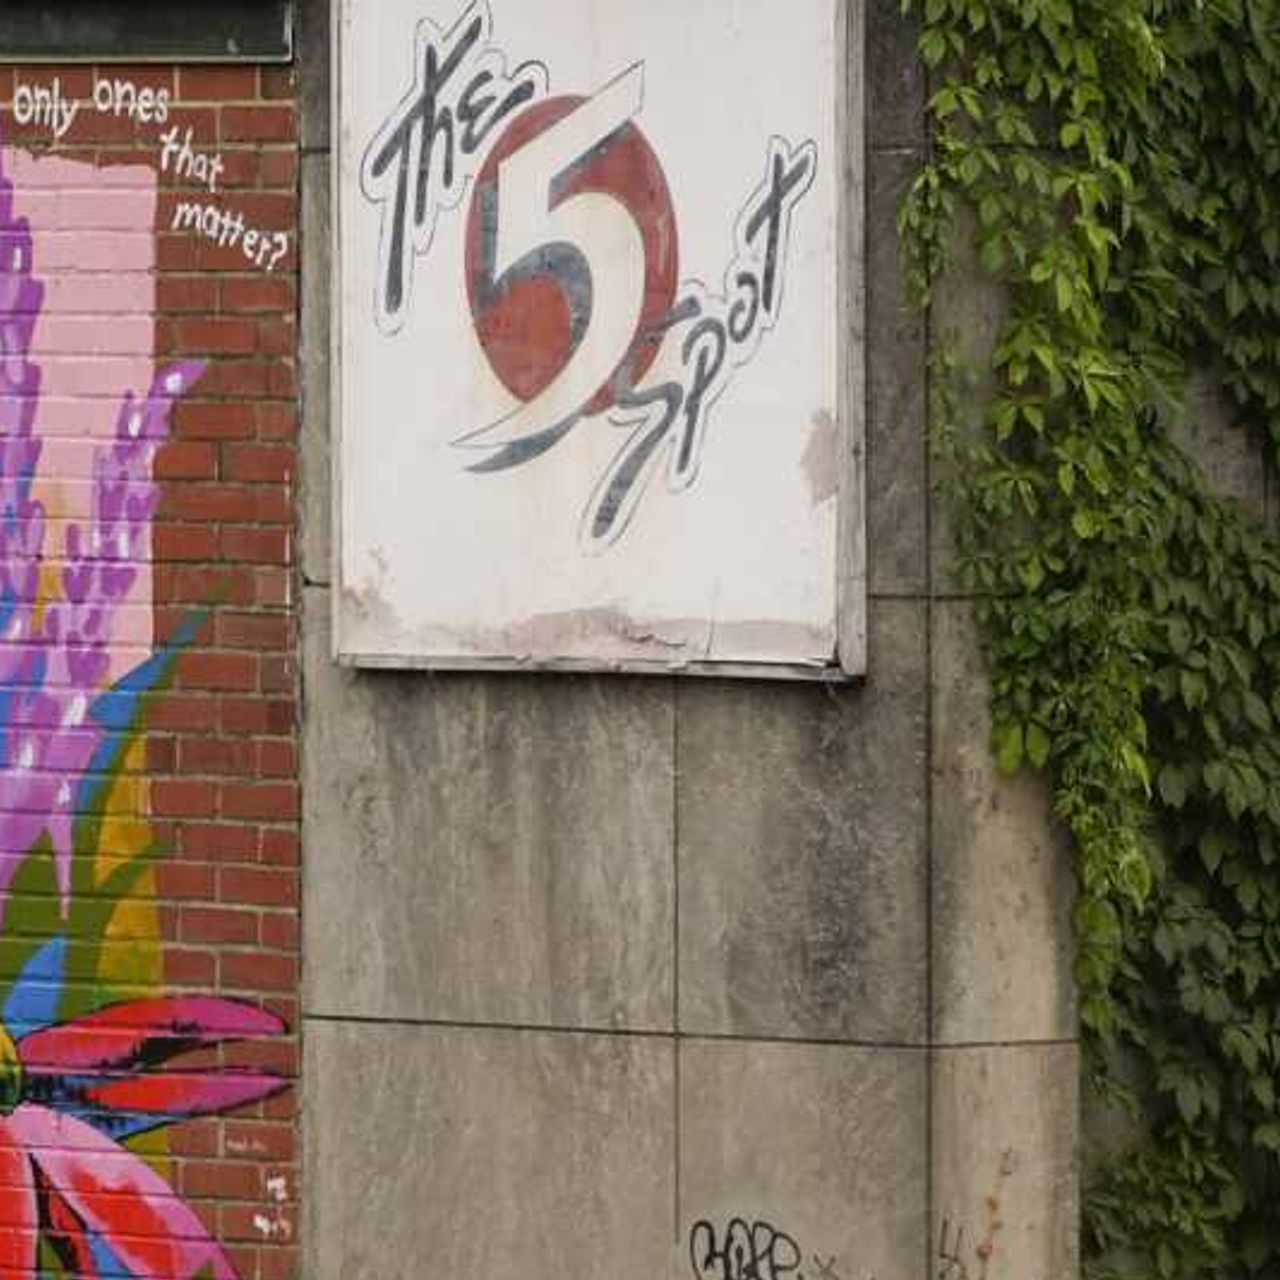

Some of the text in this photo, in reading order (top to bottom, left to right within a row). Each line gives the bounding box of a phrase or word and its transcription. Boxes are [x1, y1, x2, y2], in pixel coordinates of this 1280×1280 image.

[14, 77, 80, 137] only
[94, 78, 169, 124] ones
[160, 125, 224, 193] that
[171, 202, 289, 271] matter?
[448, 58, 646, 472] 5
[588, 145, 812, 545] Spot
